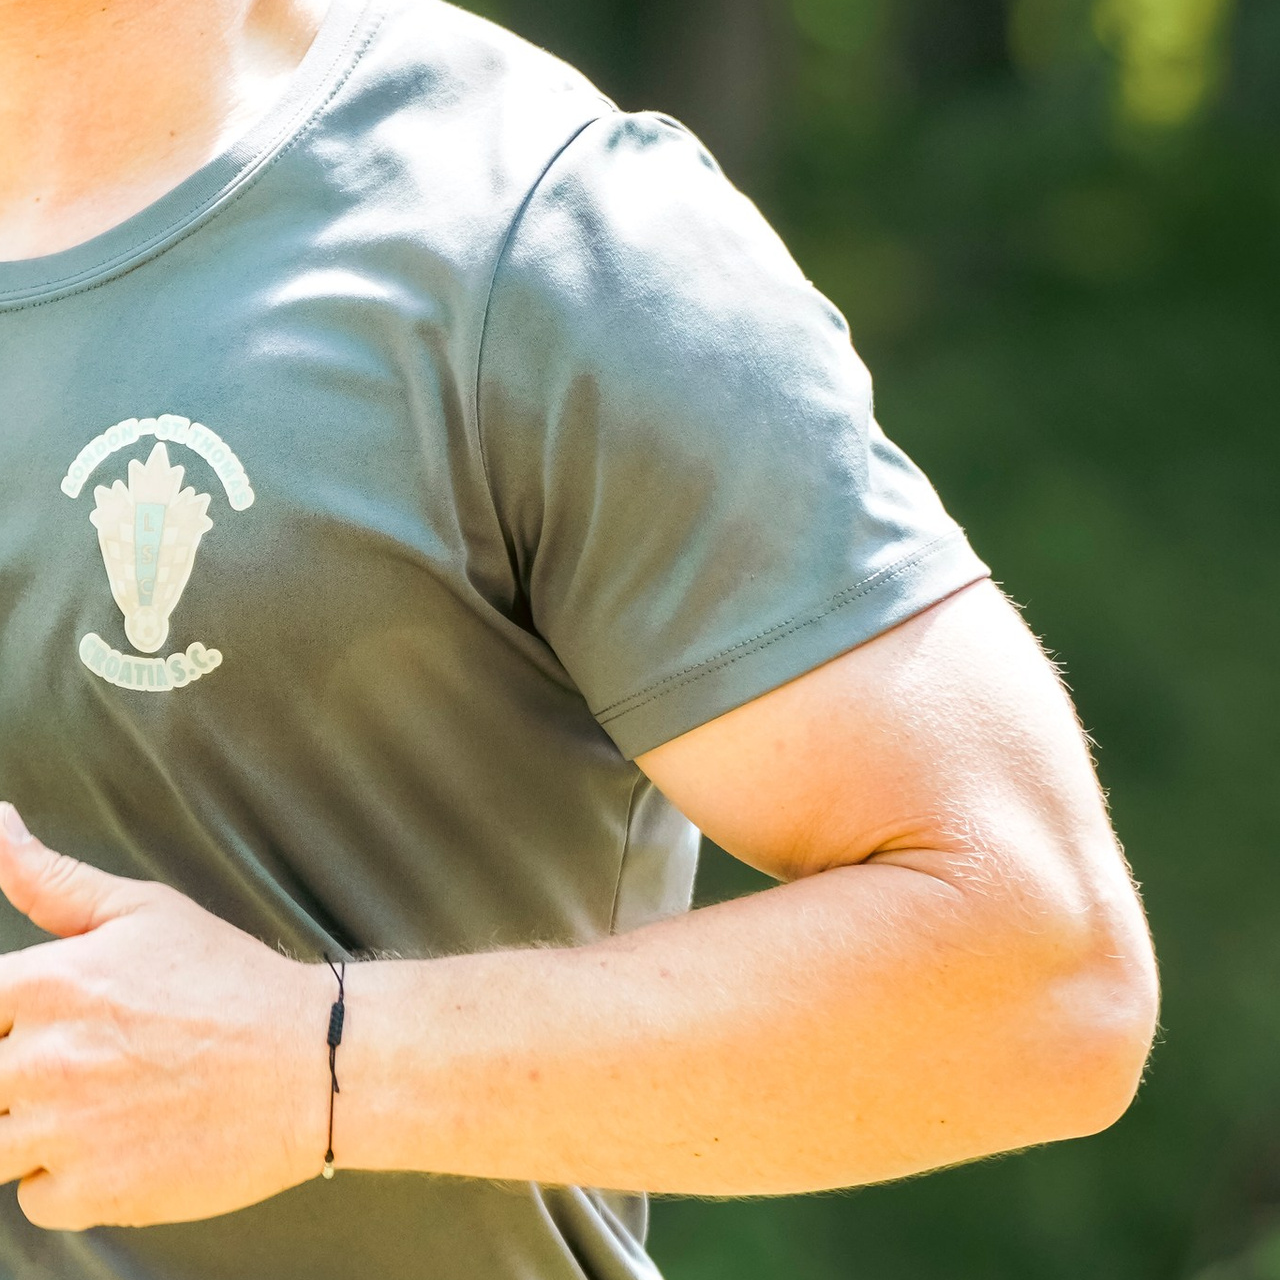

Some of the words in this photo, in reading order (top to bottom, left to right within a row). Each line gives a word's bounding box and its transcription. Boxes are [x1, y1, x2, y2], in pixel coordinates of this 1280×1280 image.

[65, 424, 134, 492] LONDON
[190, 429, 249, 506] THOMAS
[81, 638, 169, 687] CROATIA
[170, 648, 216, 683] S.C.
